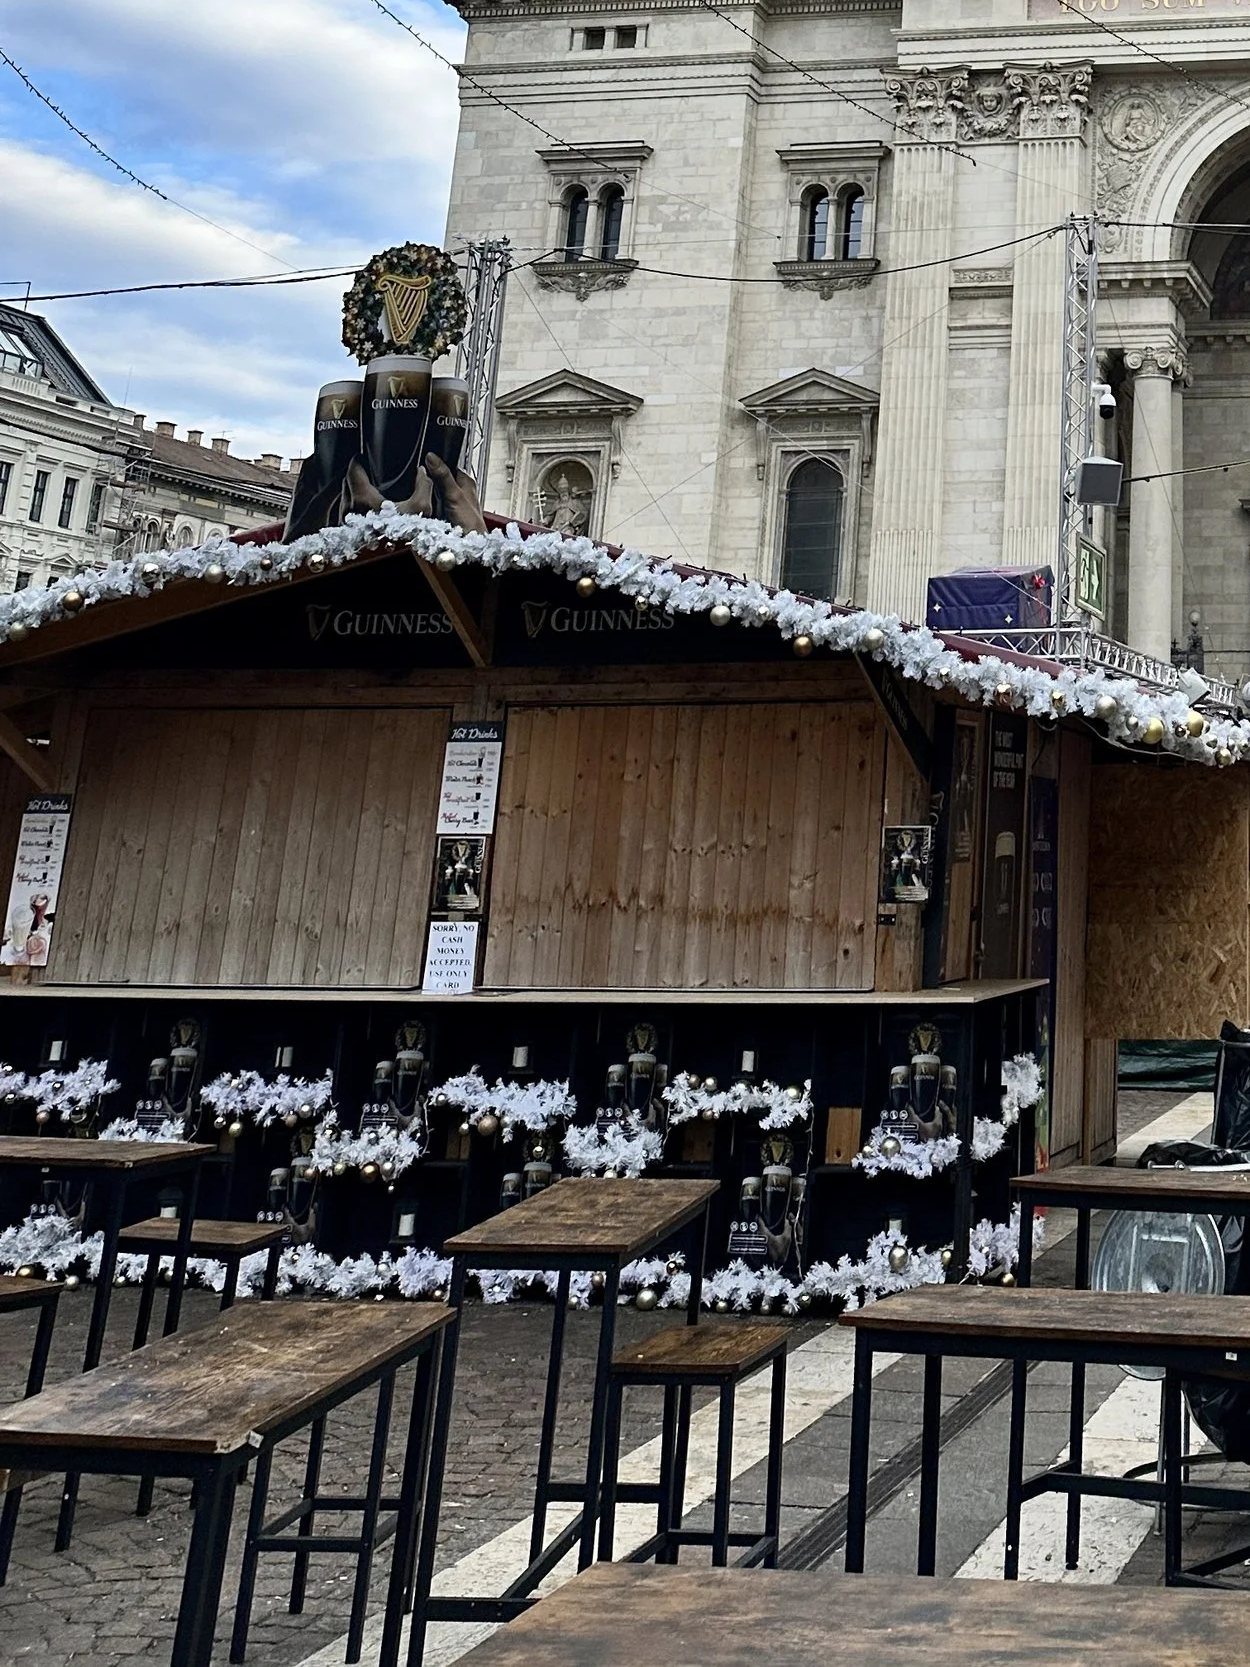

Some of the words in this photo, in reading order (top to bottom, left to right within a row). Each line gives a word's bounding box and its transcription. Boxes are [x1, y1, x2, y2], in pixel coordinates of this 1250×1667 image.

[371, 398, 419, 410] GUINNESS
[317, 418, 358, 432] GUINNESS
[333, 610, 452, 635] GUINNESS
[550, 607, 674, 632] GUINNESS
[441, 936, 463, 944] CASH
[436, 981, 459, 989] CARD
